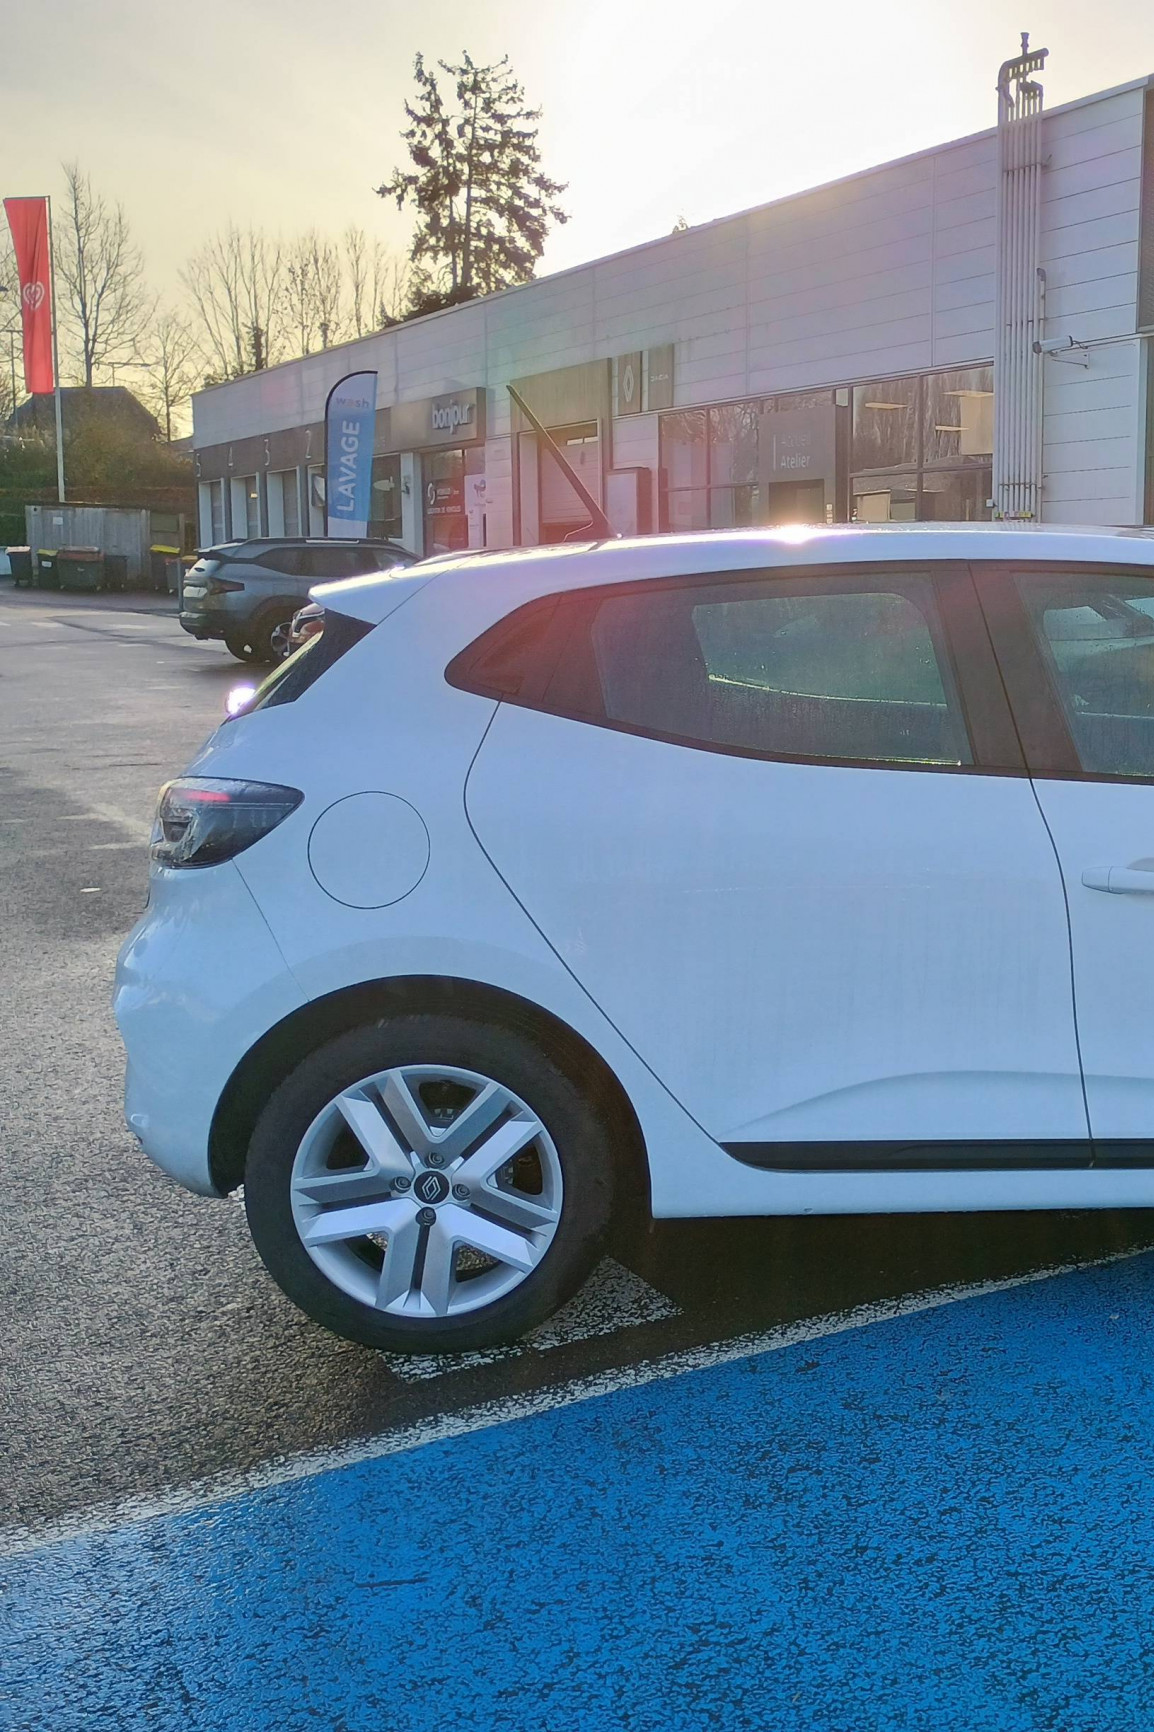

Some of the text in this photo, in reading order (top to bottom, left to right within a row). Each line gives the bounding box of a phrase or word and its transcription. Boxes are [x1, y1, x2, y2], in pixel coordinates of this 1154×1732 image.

[431, 399, 470, 434] bonjour
[263, 438, 271, 466] 3
[336, 420, 360, 512] LAVAGE
[780, 452, 811, 469] Atelier
